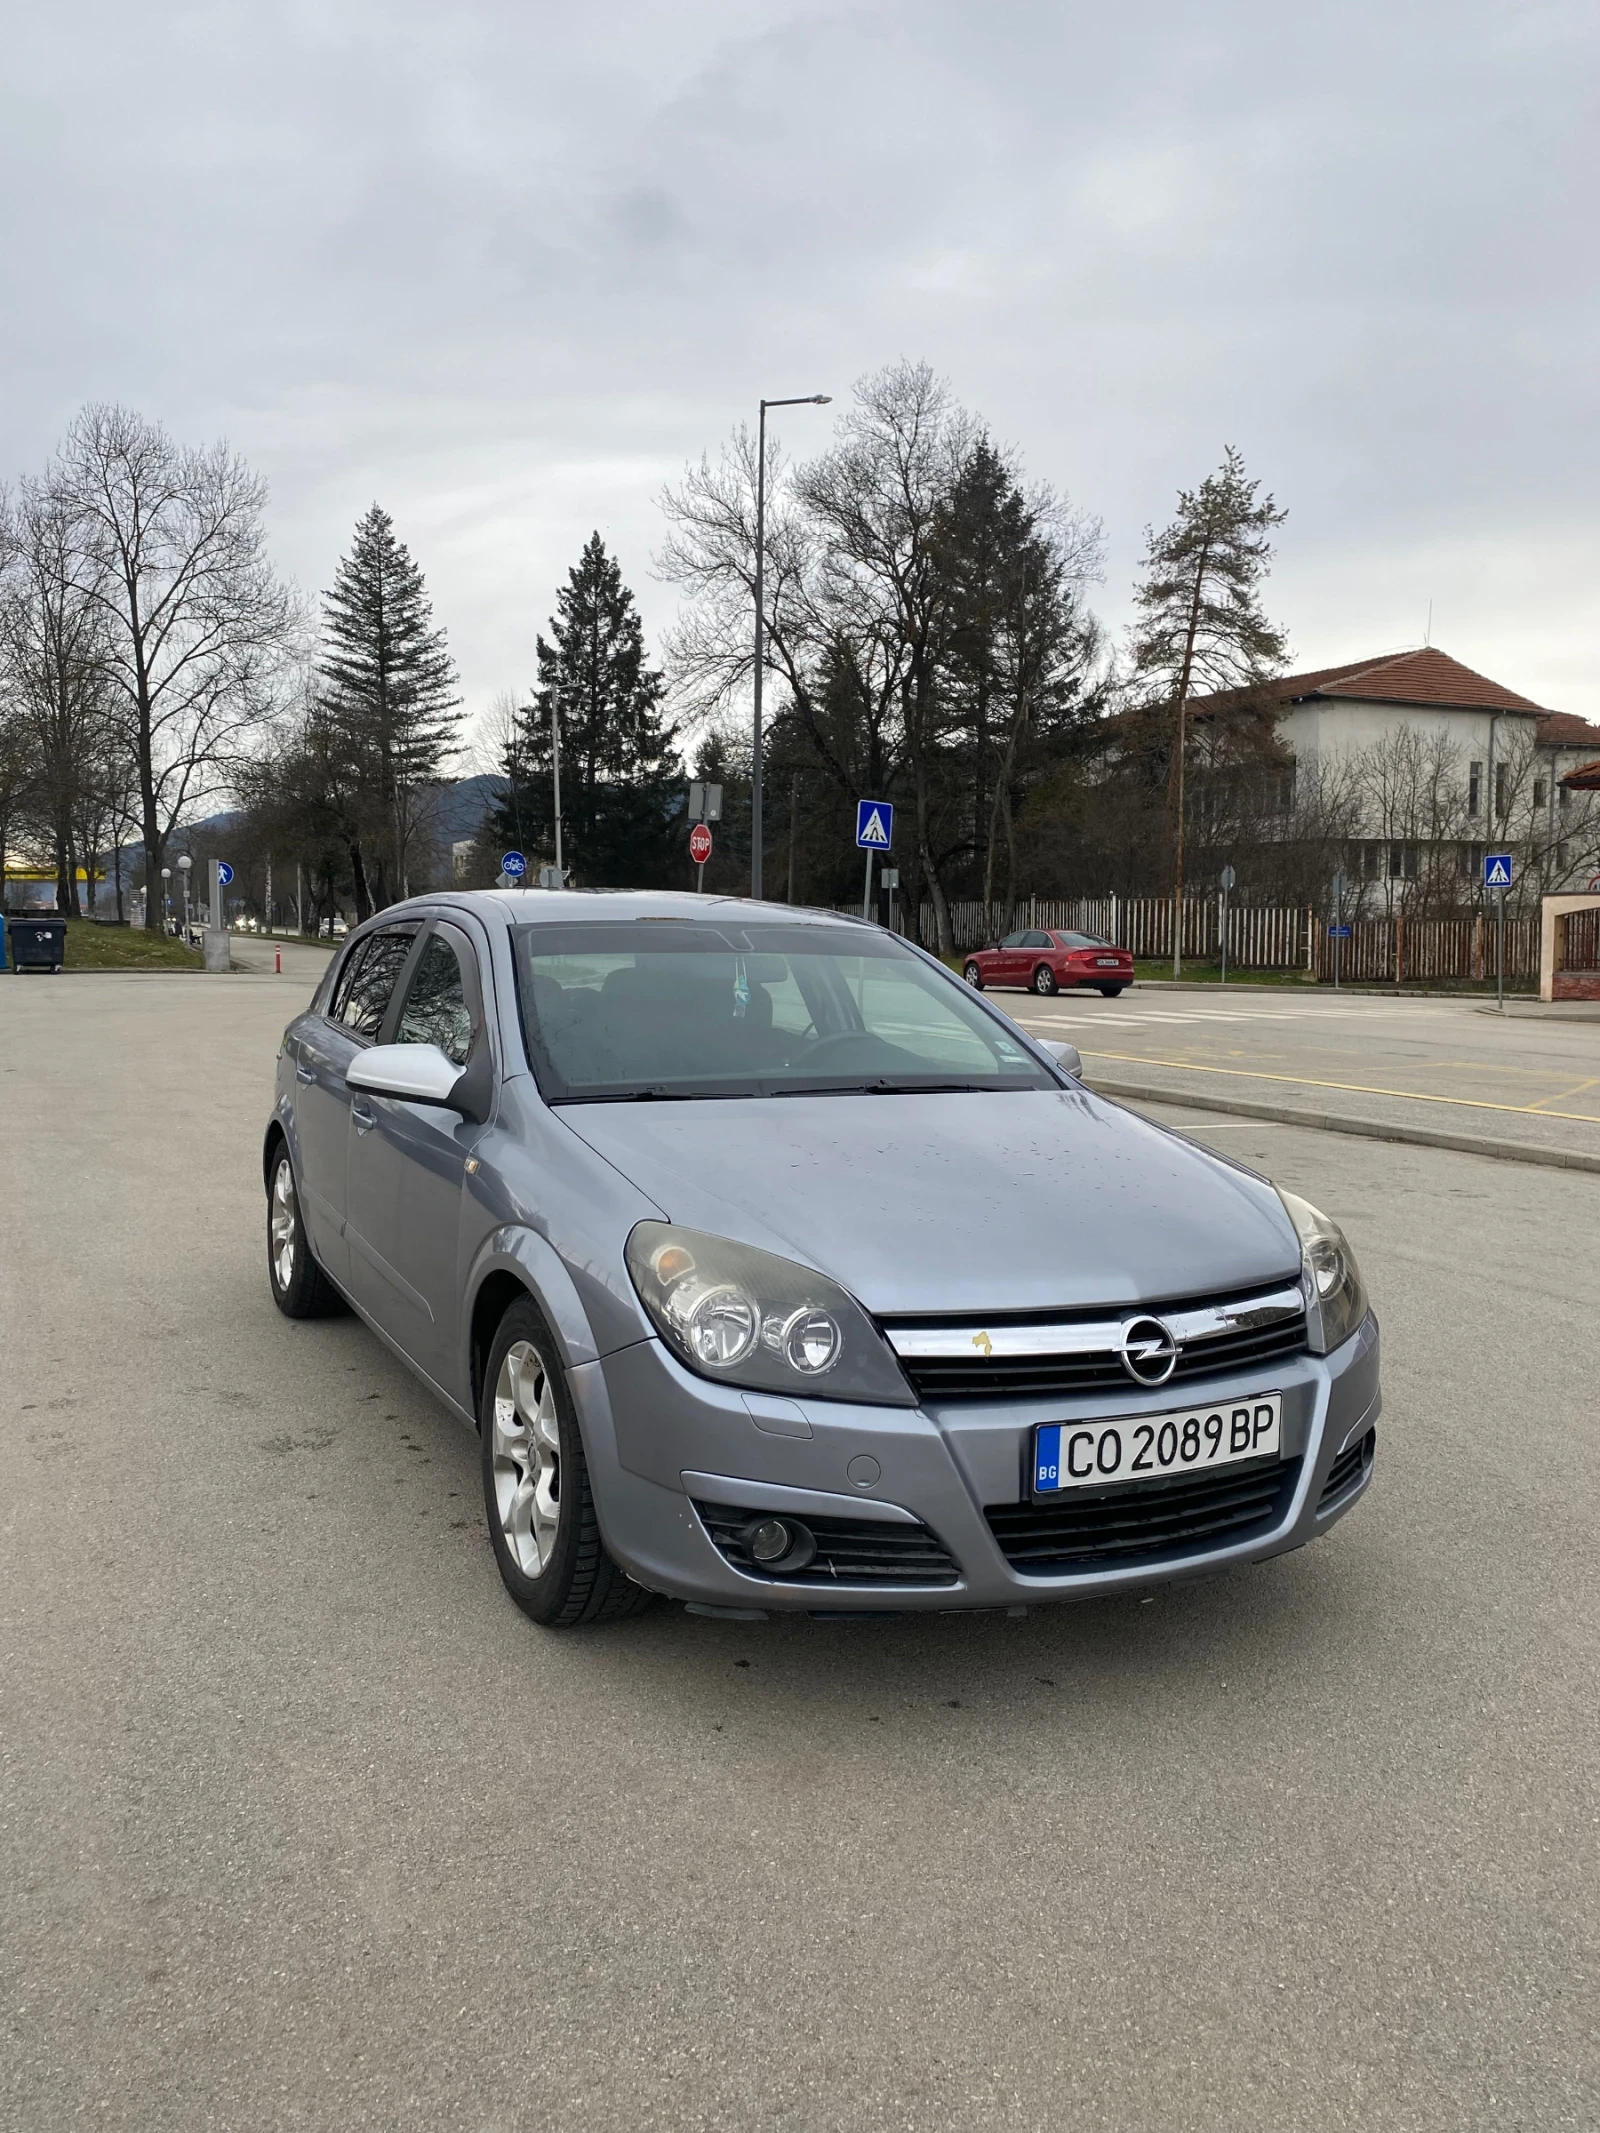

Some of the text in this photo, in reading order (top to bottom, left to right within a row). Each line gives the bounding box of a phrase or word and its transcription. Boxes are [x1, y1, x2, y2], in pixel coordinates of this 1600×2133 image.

[692, 836, 710, 851] STOP
[1067, 1403, 1274, 1478] CO 2089 BP
[1038, 1466, 1057, 1481] BG
